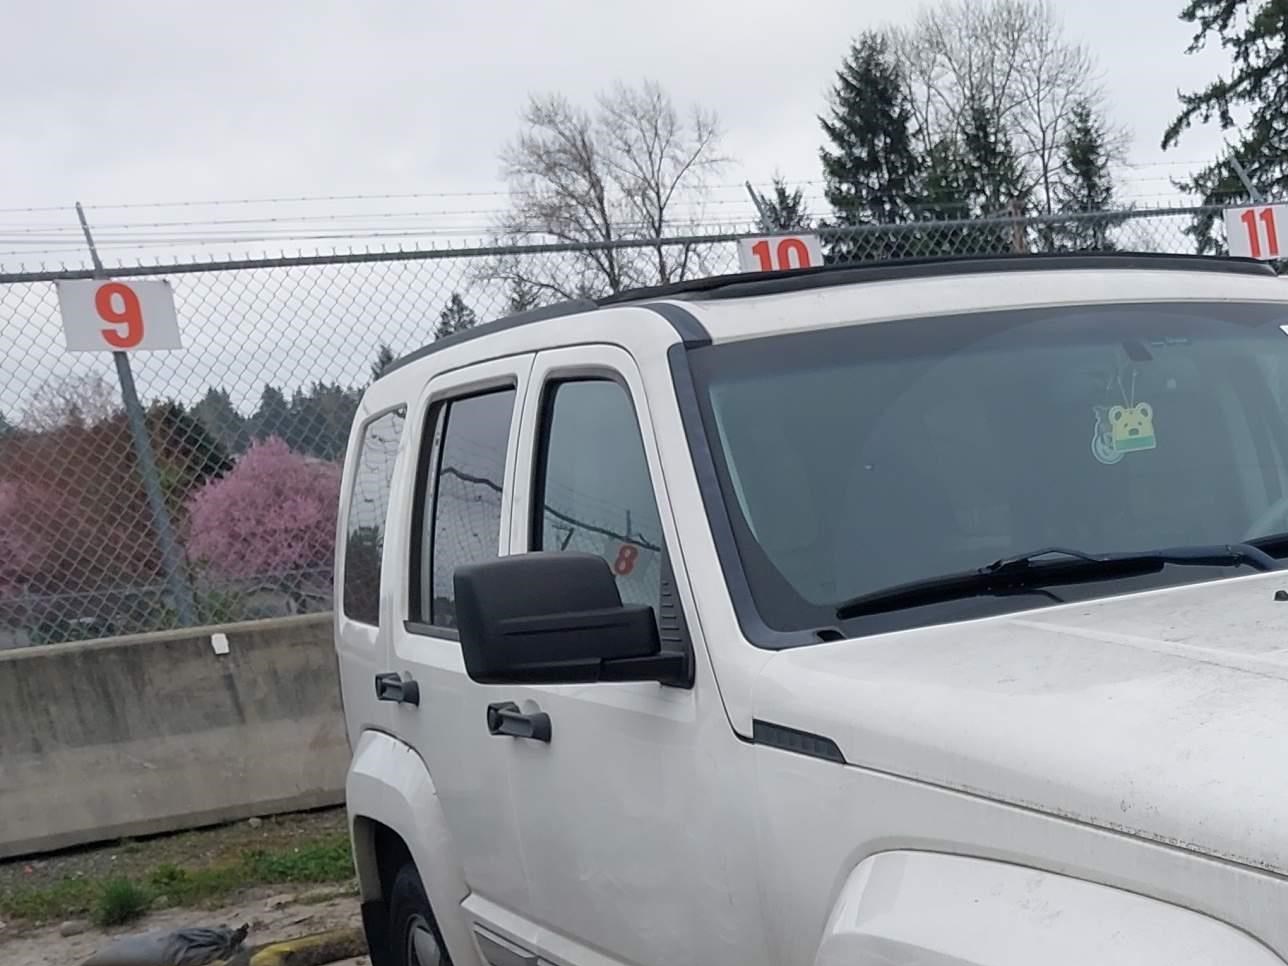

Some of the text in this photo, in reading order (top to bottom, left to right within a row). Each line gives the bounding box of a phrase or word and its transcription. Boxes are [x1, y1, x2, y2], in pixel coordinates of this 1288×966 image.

[1242, 208, 1278, 257] 11
[752, 238, 810, 272] 10
[95, 282, 145, 348] 9
[614, 545, 639, 575] 8
